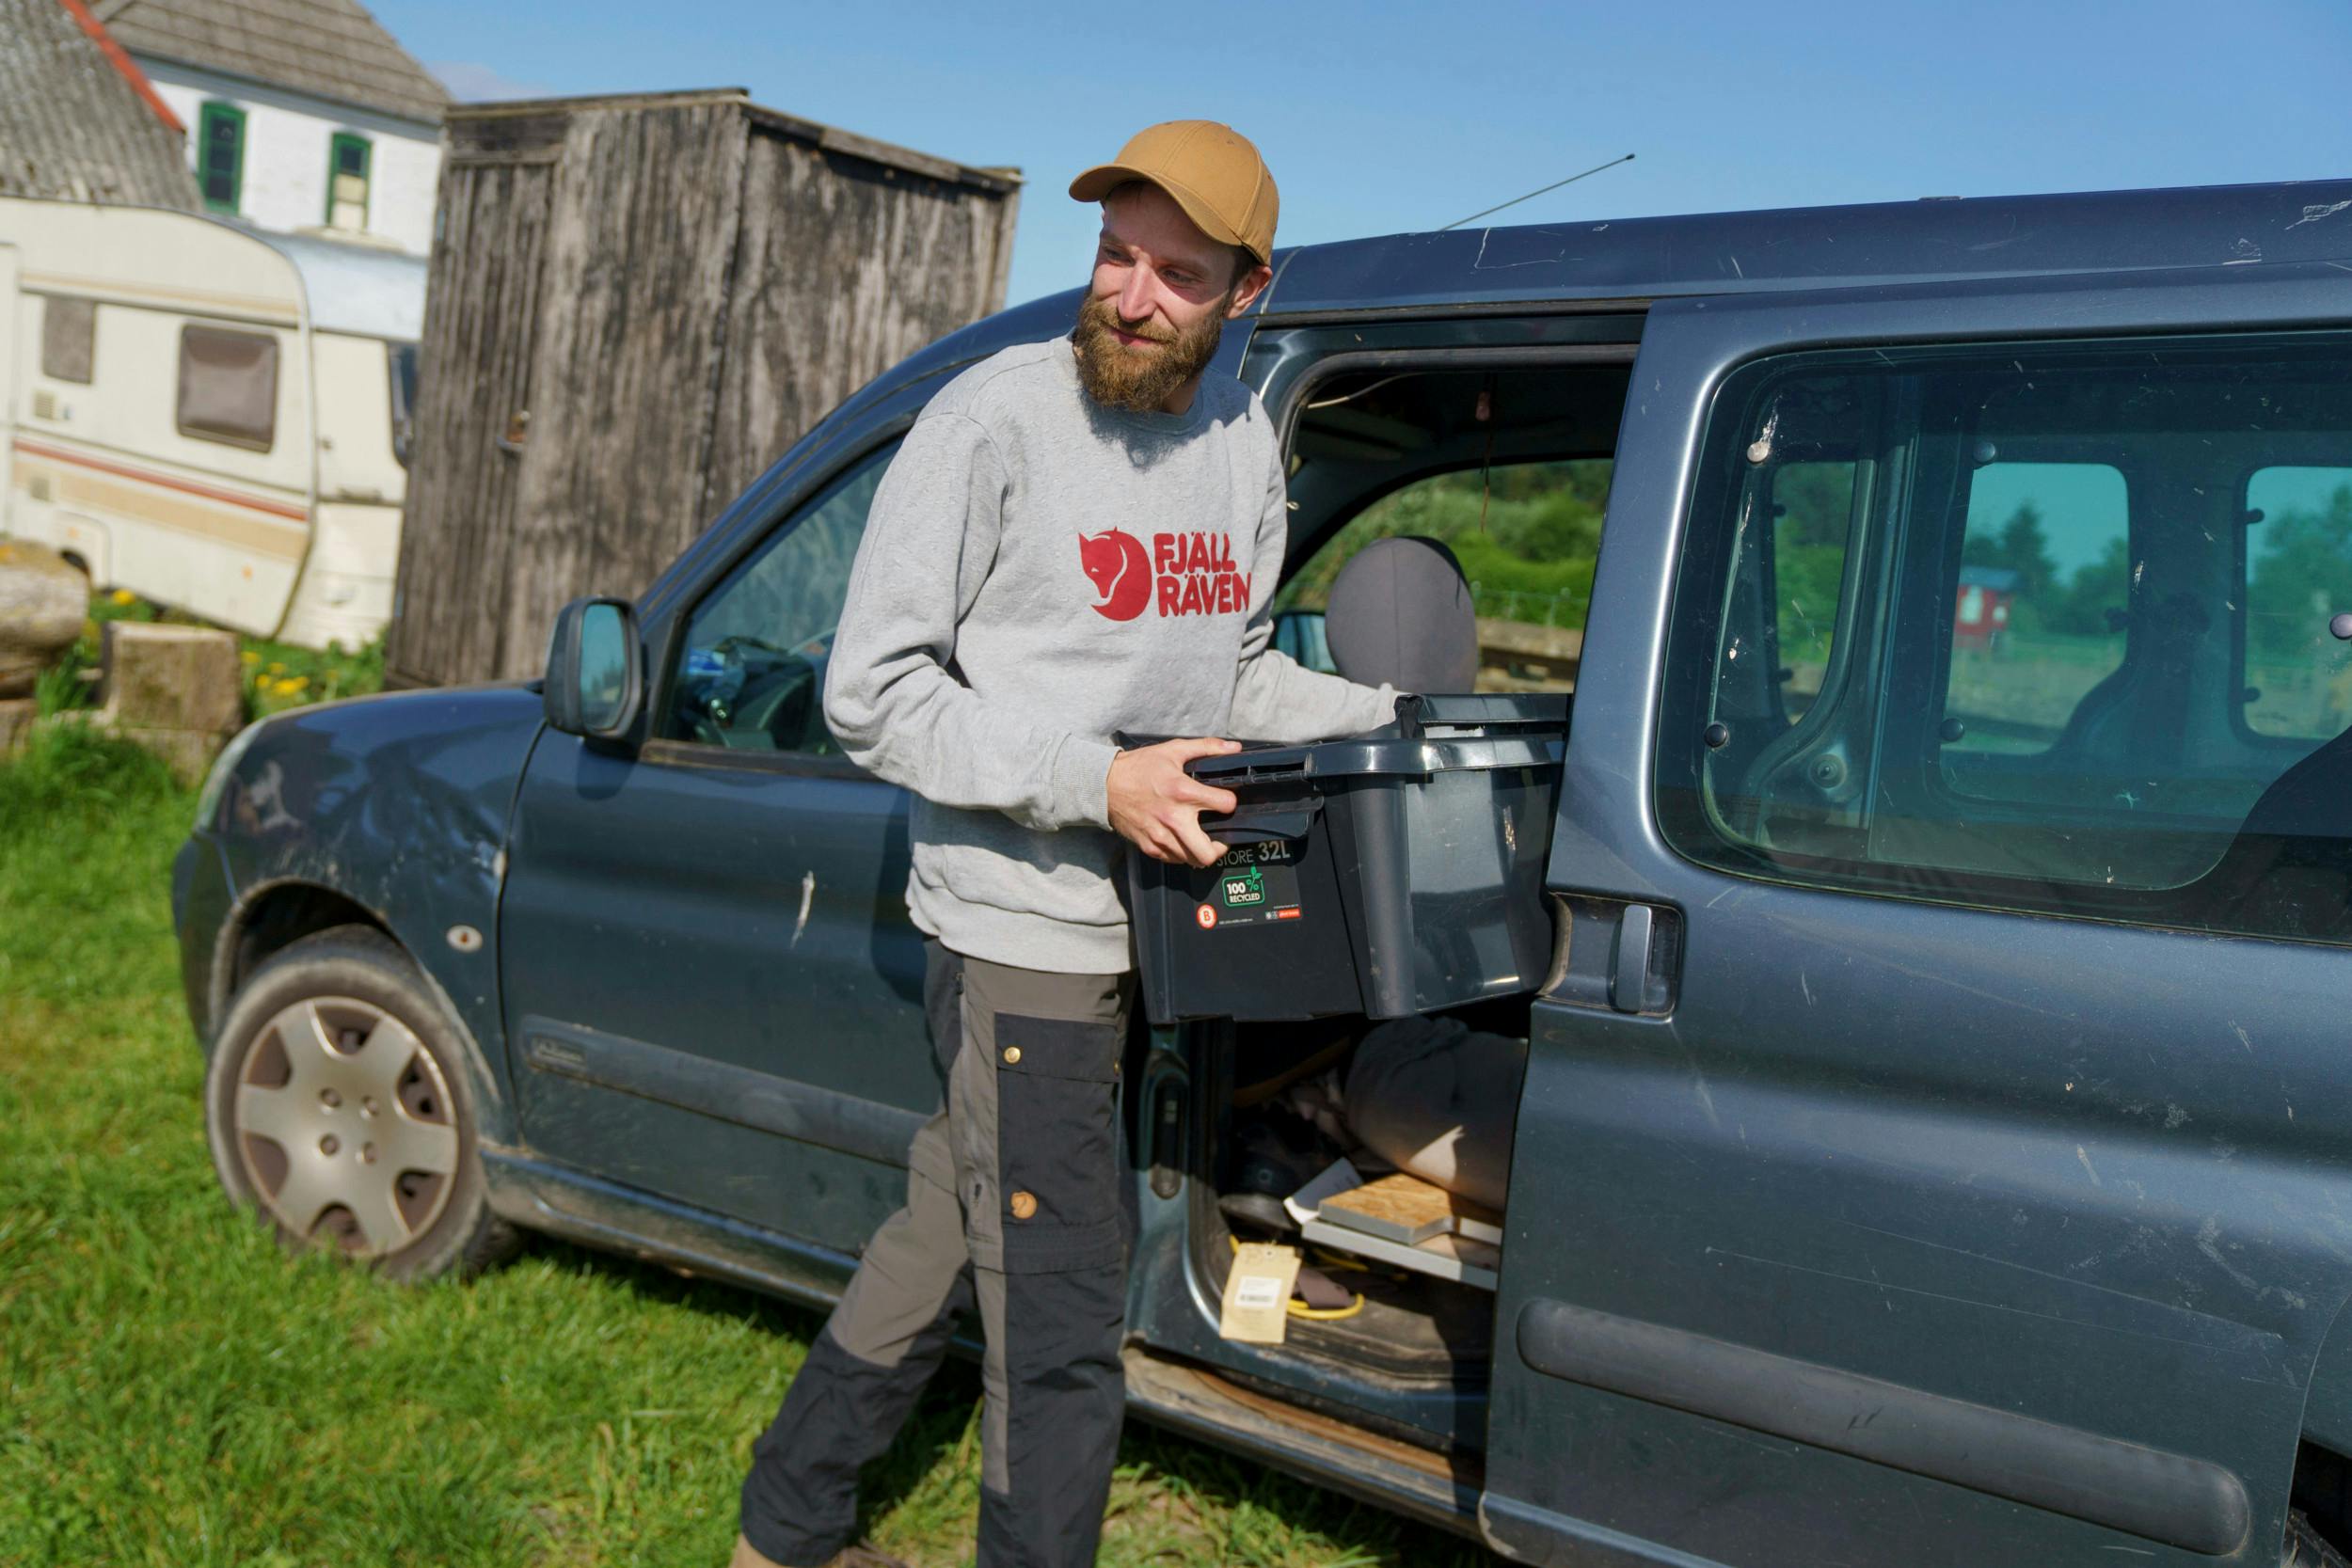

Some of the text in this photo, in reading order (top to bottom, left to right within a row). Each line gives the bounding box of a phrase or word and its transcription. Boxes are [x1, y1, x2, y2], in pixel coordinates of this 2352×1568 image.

[1153, 531, 1236, 575] FJÄLL
[1157, 572, 1251, 618] RÄVEN
[1259, 840, 1291, 862] 32L
[1230, 893, 1261, 903] RECYCLED
